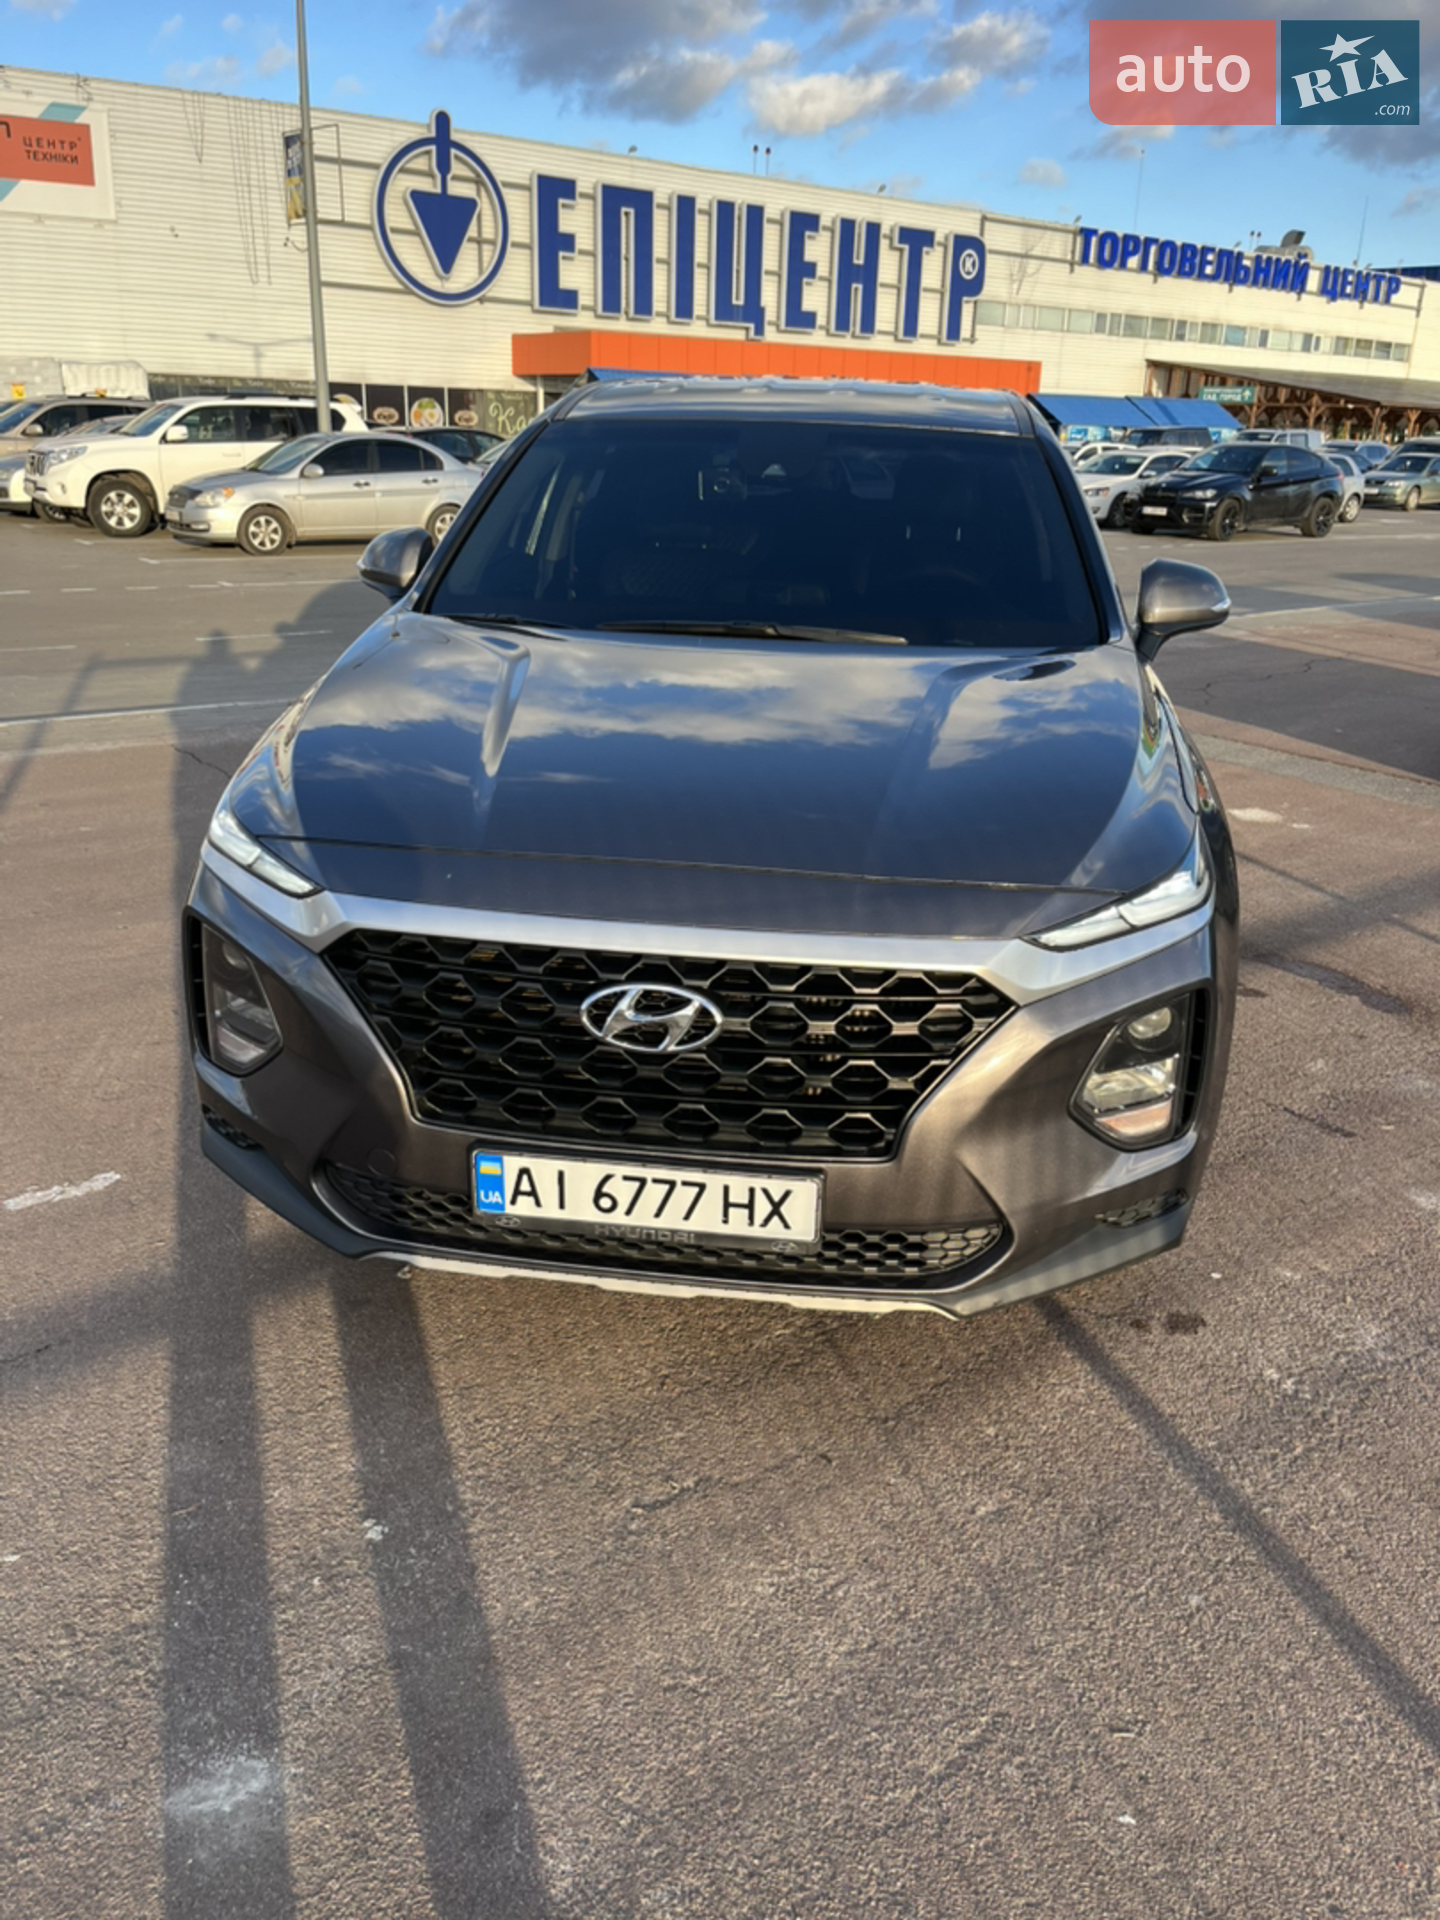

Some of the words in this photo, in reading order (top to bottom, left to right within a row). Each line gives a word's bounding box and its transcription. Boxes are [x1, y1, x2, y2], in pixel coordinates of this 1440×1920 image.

[22, 136, 78, 151] ЦЕНТР
[25, 150, 79, 165] ТЕХНІКИ
[532, 172, 986, 343] ЕПІЦЕНТР
[1079, 227, 1310, 293] ТОРГОВЕЛЬНИЙ
[1319, 264, 1401, 305] ЦЕНТР
[480, 1190, 502, 1204] UA
[510, 1167, 565, 1210] AI
[592, 1173, 707, 1222] 6777
[722, 1184, 793, 1230] HX
[595, 1223, 695, 1244] HYUNDAI
